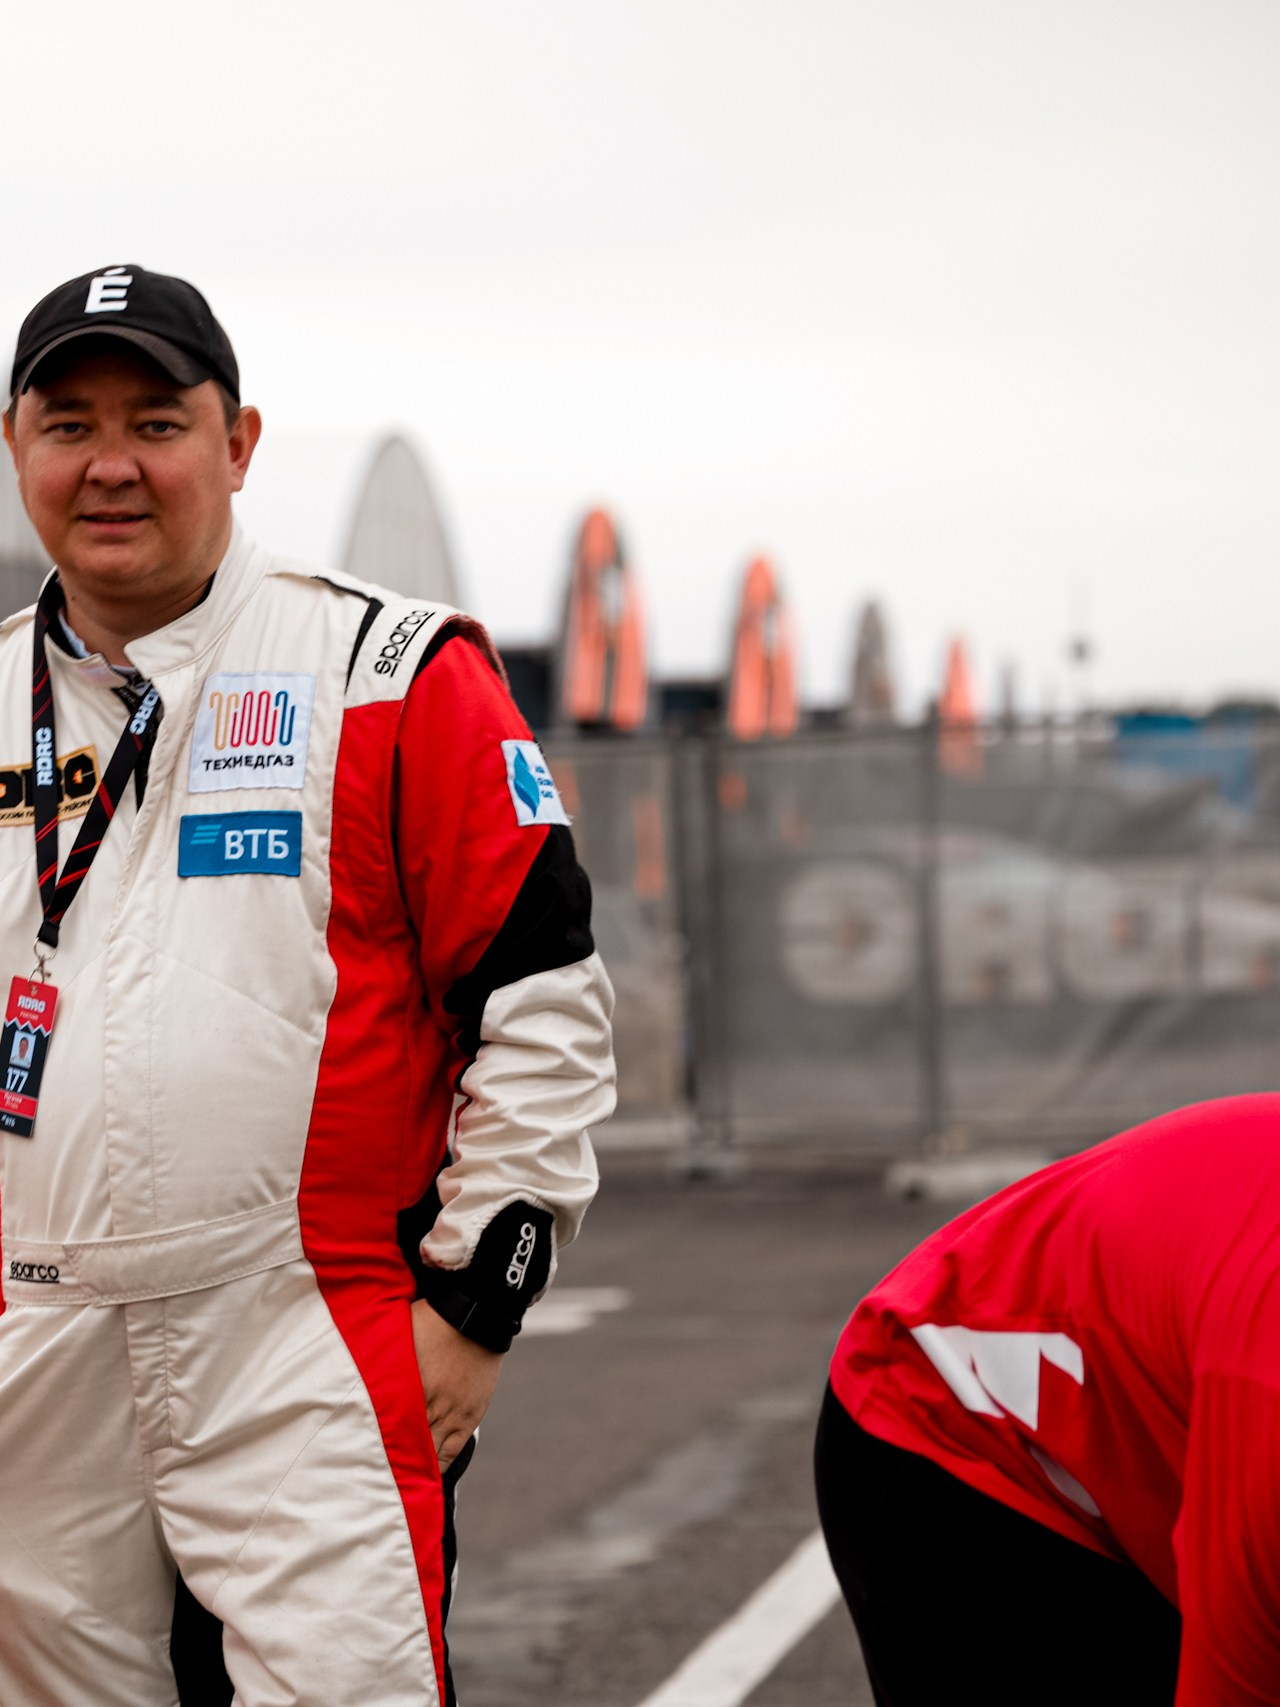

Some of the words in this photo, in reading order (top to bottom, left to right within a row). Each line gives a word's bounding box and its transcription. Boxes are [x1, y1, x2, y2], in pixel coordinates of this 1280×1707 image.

[374, 609, 436, 678] sparco
[129, 687, 159, 736] DRG
[35, 726, 54, 787] RDRG
[202, 754, 296, 772] ТЕХМЕДГАЗ
[224, 829, 290, 861] ВТБ
[5, 1066, 30, 1093] 177
[10, 1260, 60, 1284] sparco
